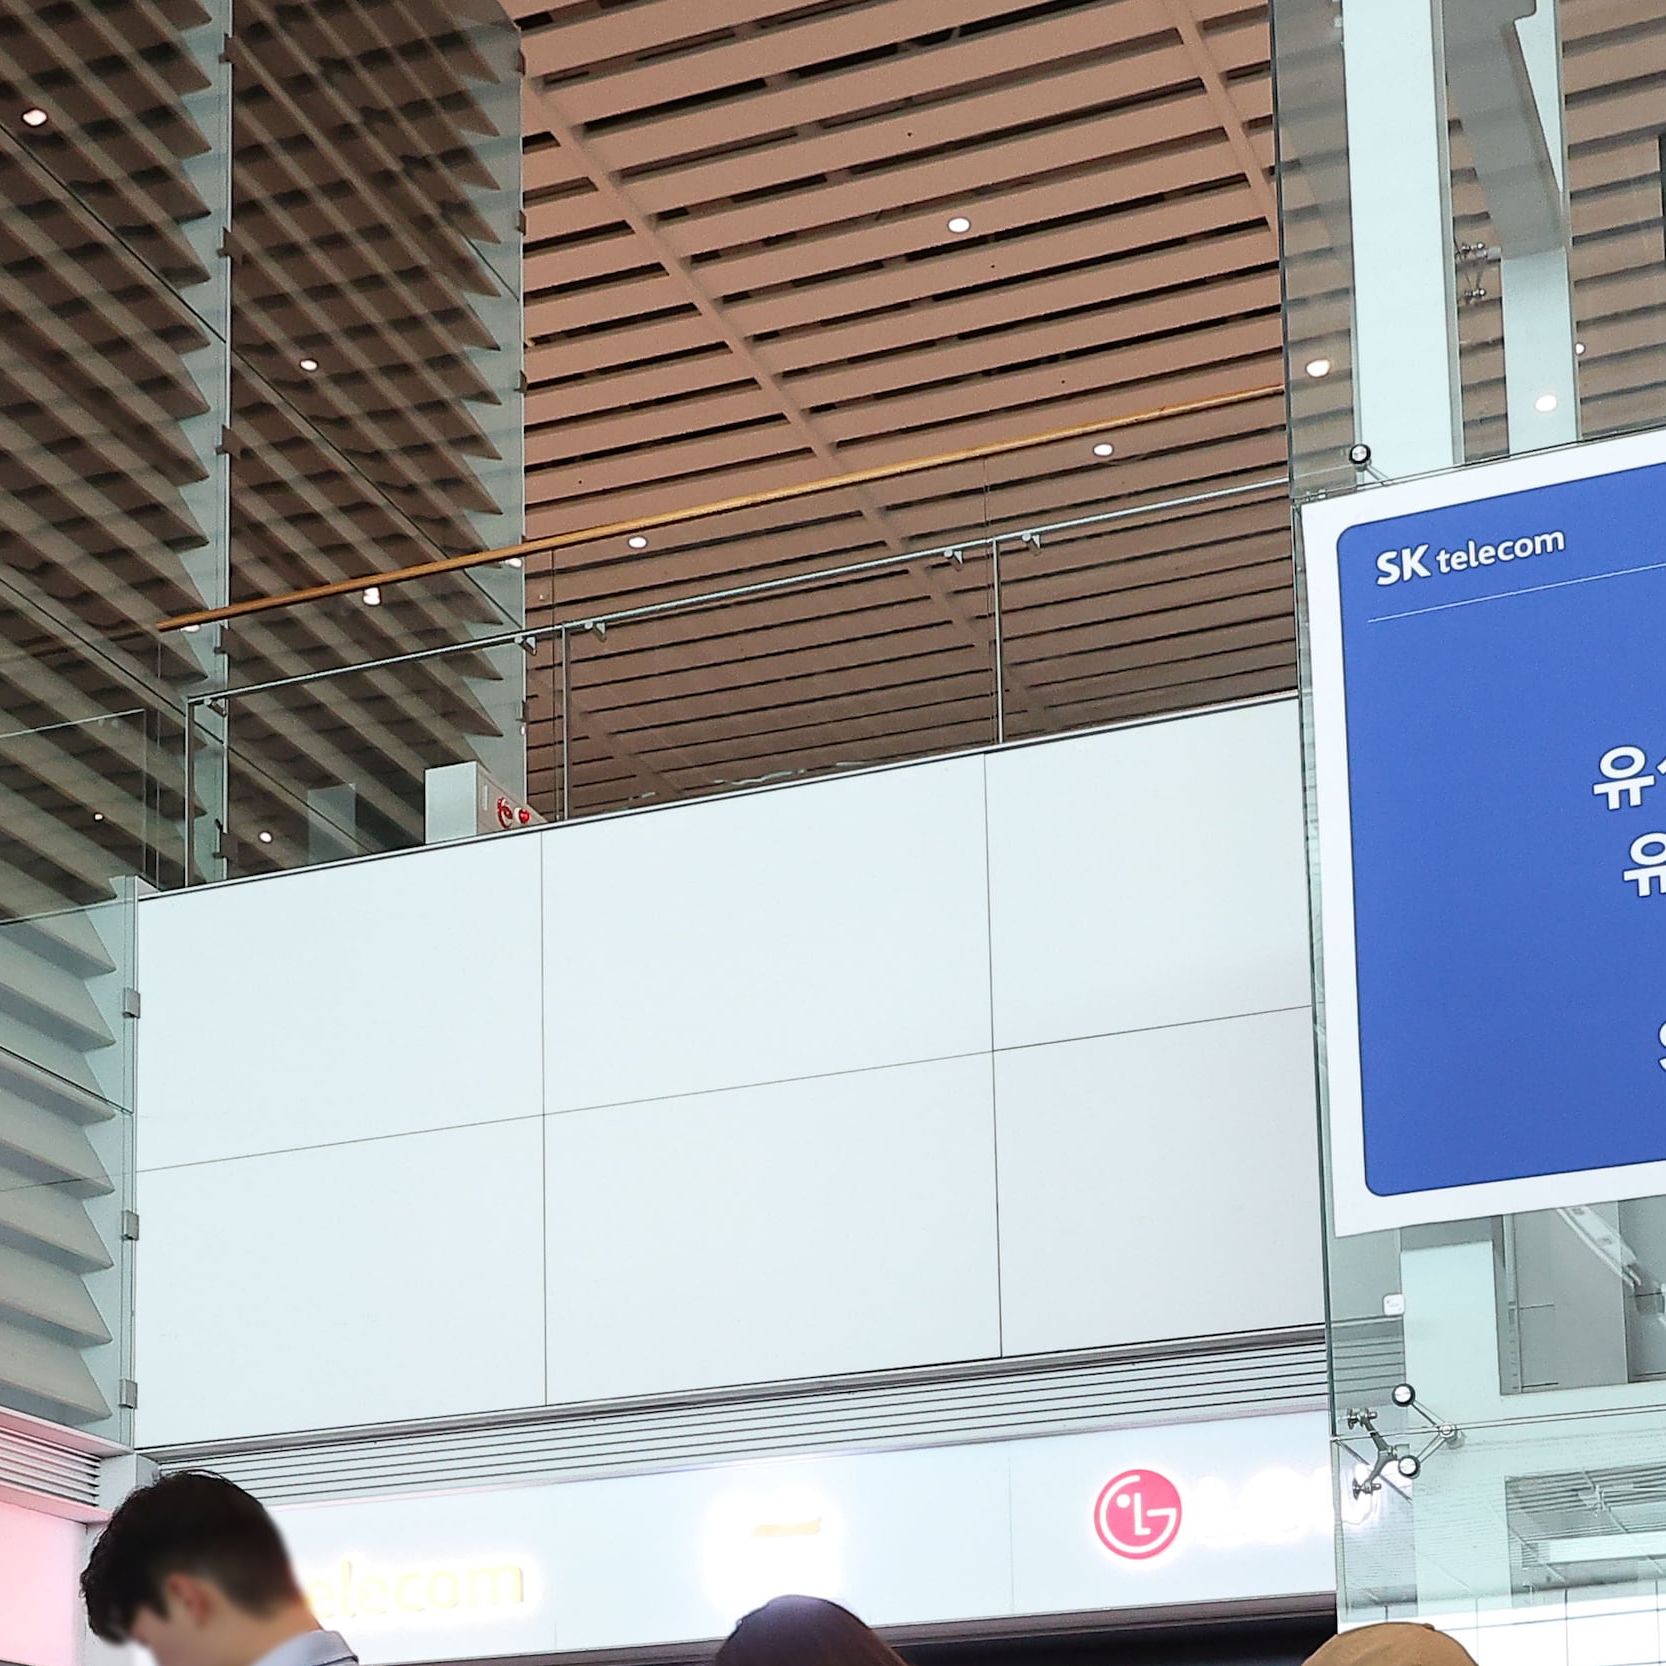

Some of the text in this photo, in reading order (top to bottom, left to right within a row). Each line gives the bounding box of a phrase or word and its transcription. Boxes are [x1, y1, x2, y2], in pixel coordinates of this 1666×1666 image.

[1377, 528, 1565, 584] SK telecom
[306, 1559, 524, 1618] elecom
